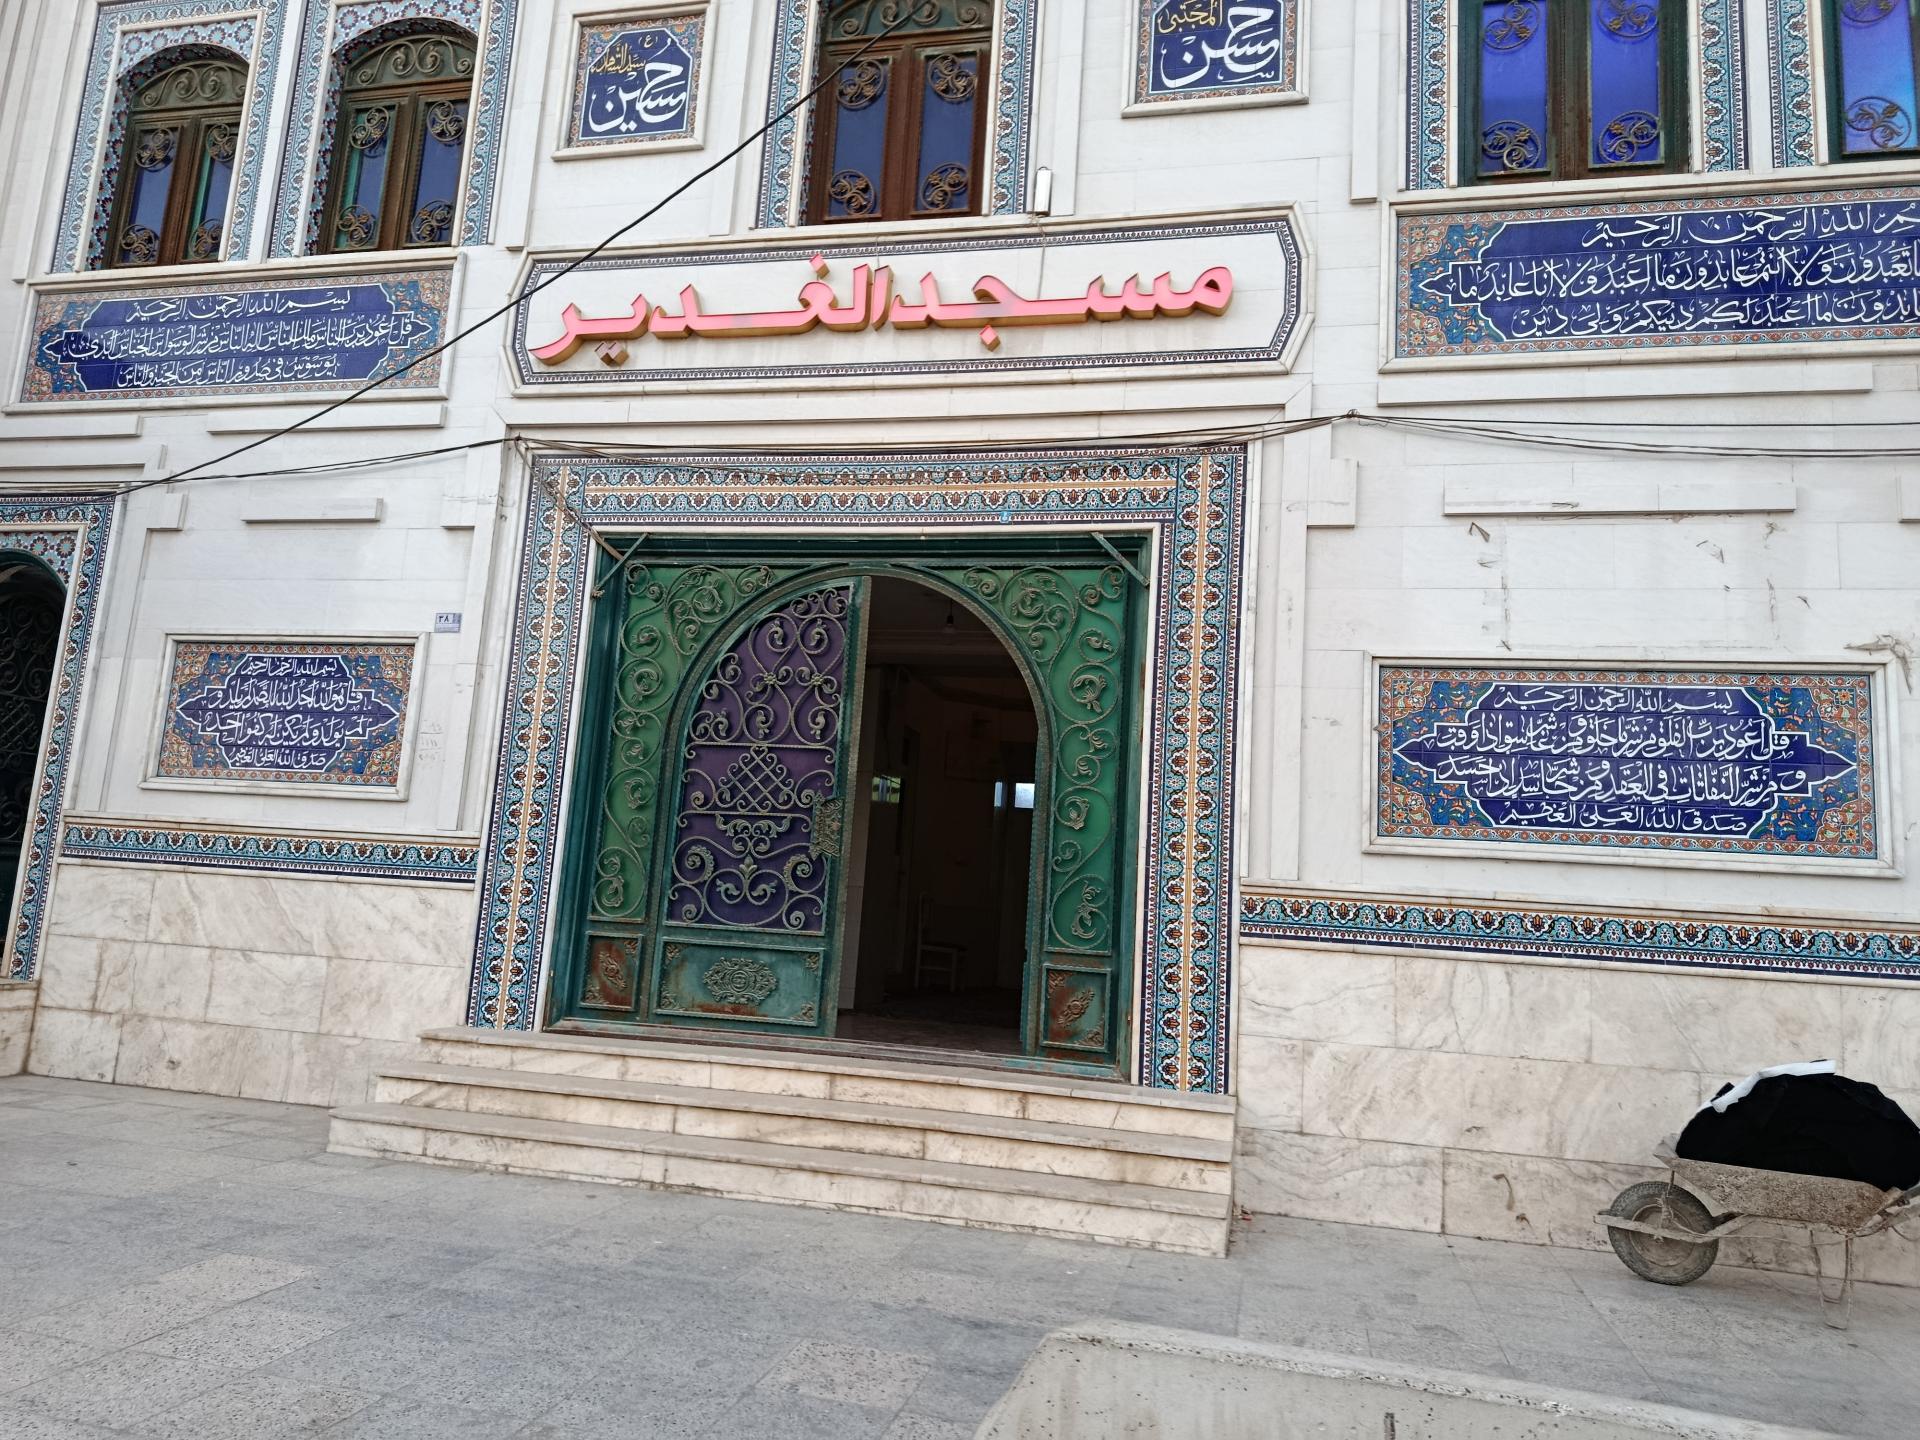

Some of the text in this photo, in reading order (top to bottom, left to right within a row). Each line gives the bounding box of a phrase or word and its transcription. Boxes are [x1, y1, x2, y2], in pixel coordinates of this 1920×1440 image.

[1160, 7, 1280, 88] حسن
[1818, 203, 1871, 239] الله
[248, 293, 279, 317] الله
[891, 264, 1233, 352] مسجد
[1634, 690, 1662, 712] الله
[1751, 724, 1790, 760] قل
[1645, 806, 1681, 832] الله
